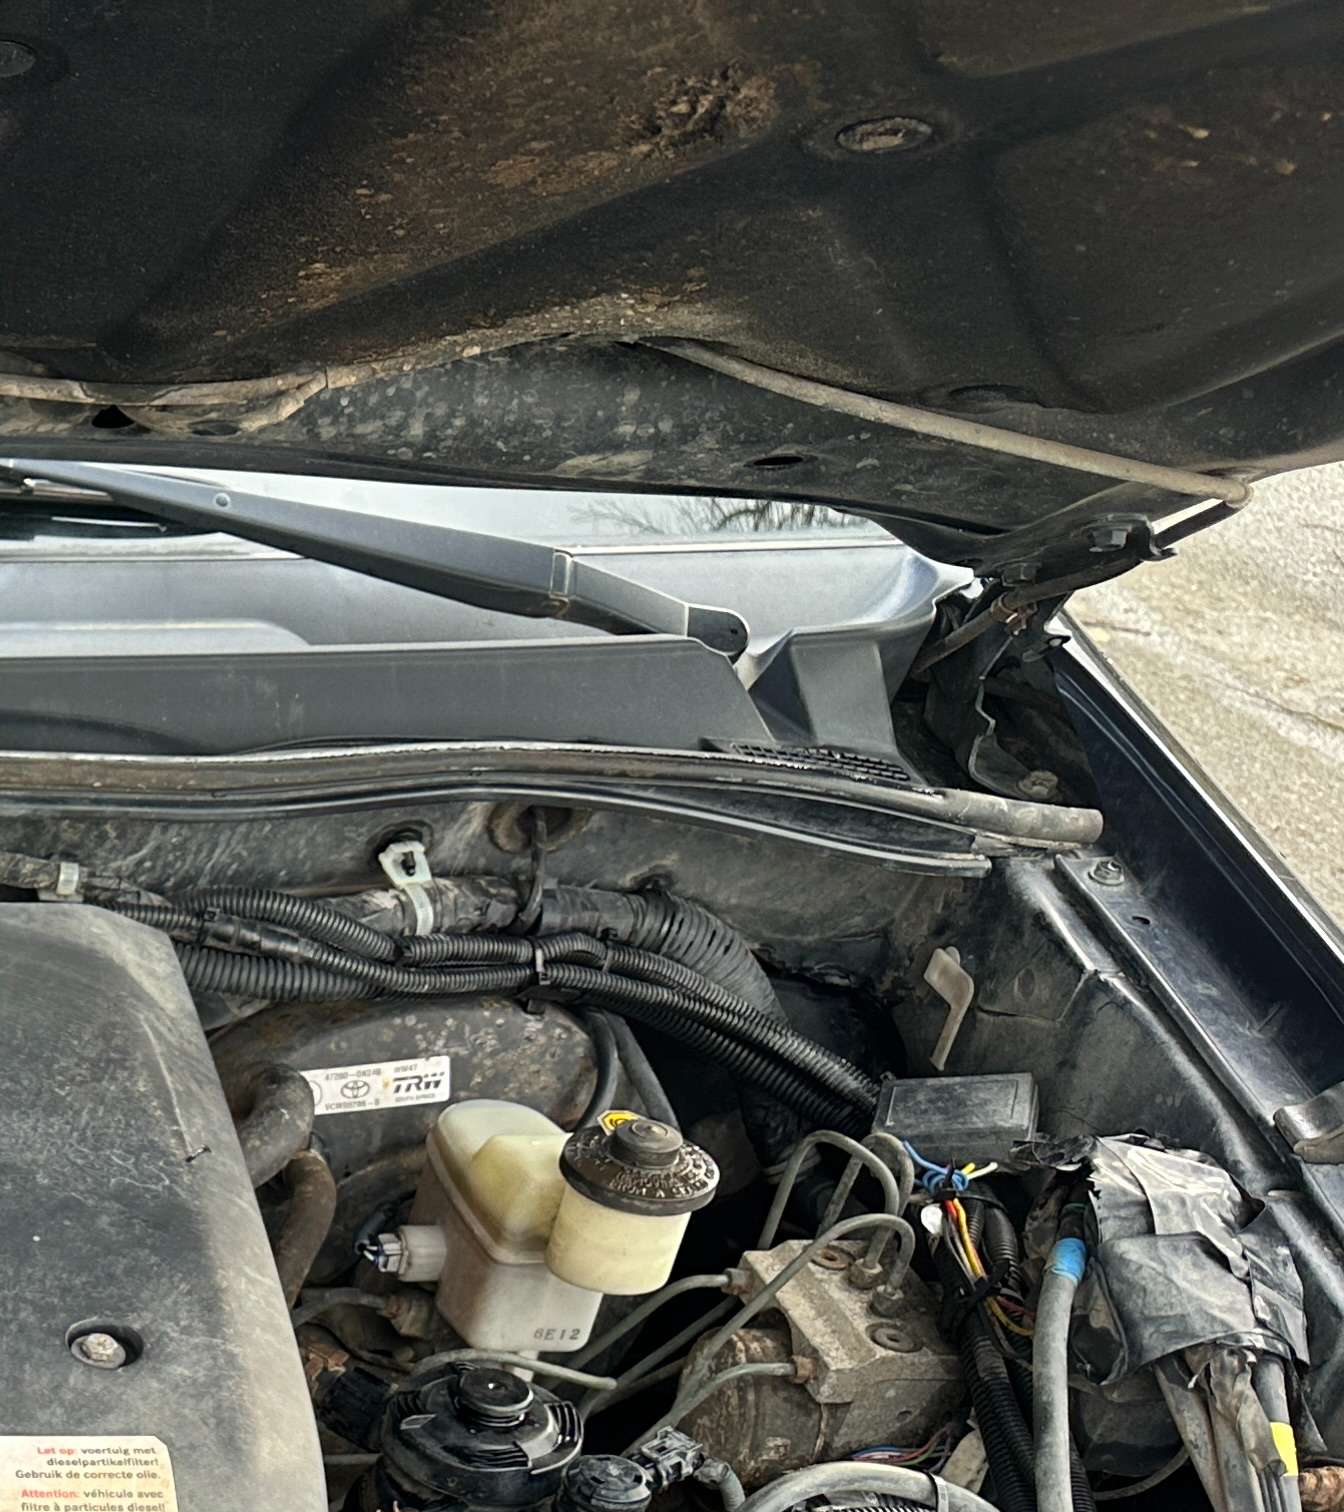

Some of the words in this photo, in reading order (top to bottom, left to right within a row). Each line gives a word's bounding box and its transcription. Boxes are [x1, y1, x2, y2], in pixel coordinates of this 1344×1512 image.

[393, 1072, 445, 1094] TRW
[36, 1447, 56, 1455] Let
[59, 1448, 77, 1457] op:
[81, 1446, 130, 1456] voertuig
[46, 1458, 159, 1467] dieselpartikelfilter!
[15, 1470, 62, 1479] Gebruik
[66, 1470, 80, 1479] de
[83, 1471, 133, 1479] correcte
[136, 1470, 161, 1479] olie.
[21, 1489, 79, 1498] Attention:
[83, 1489, 134, 1498] véhicule
[21, 1502, 50, 1512] filtre
[53, 1502, 61, 1511] à
[64, 1502, 124, 1512] particules
[127, 1503, 165, 1512] diesel!
